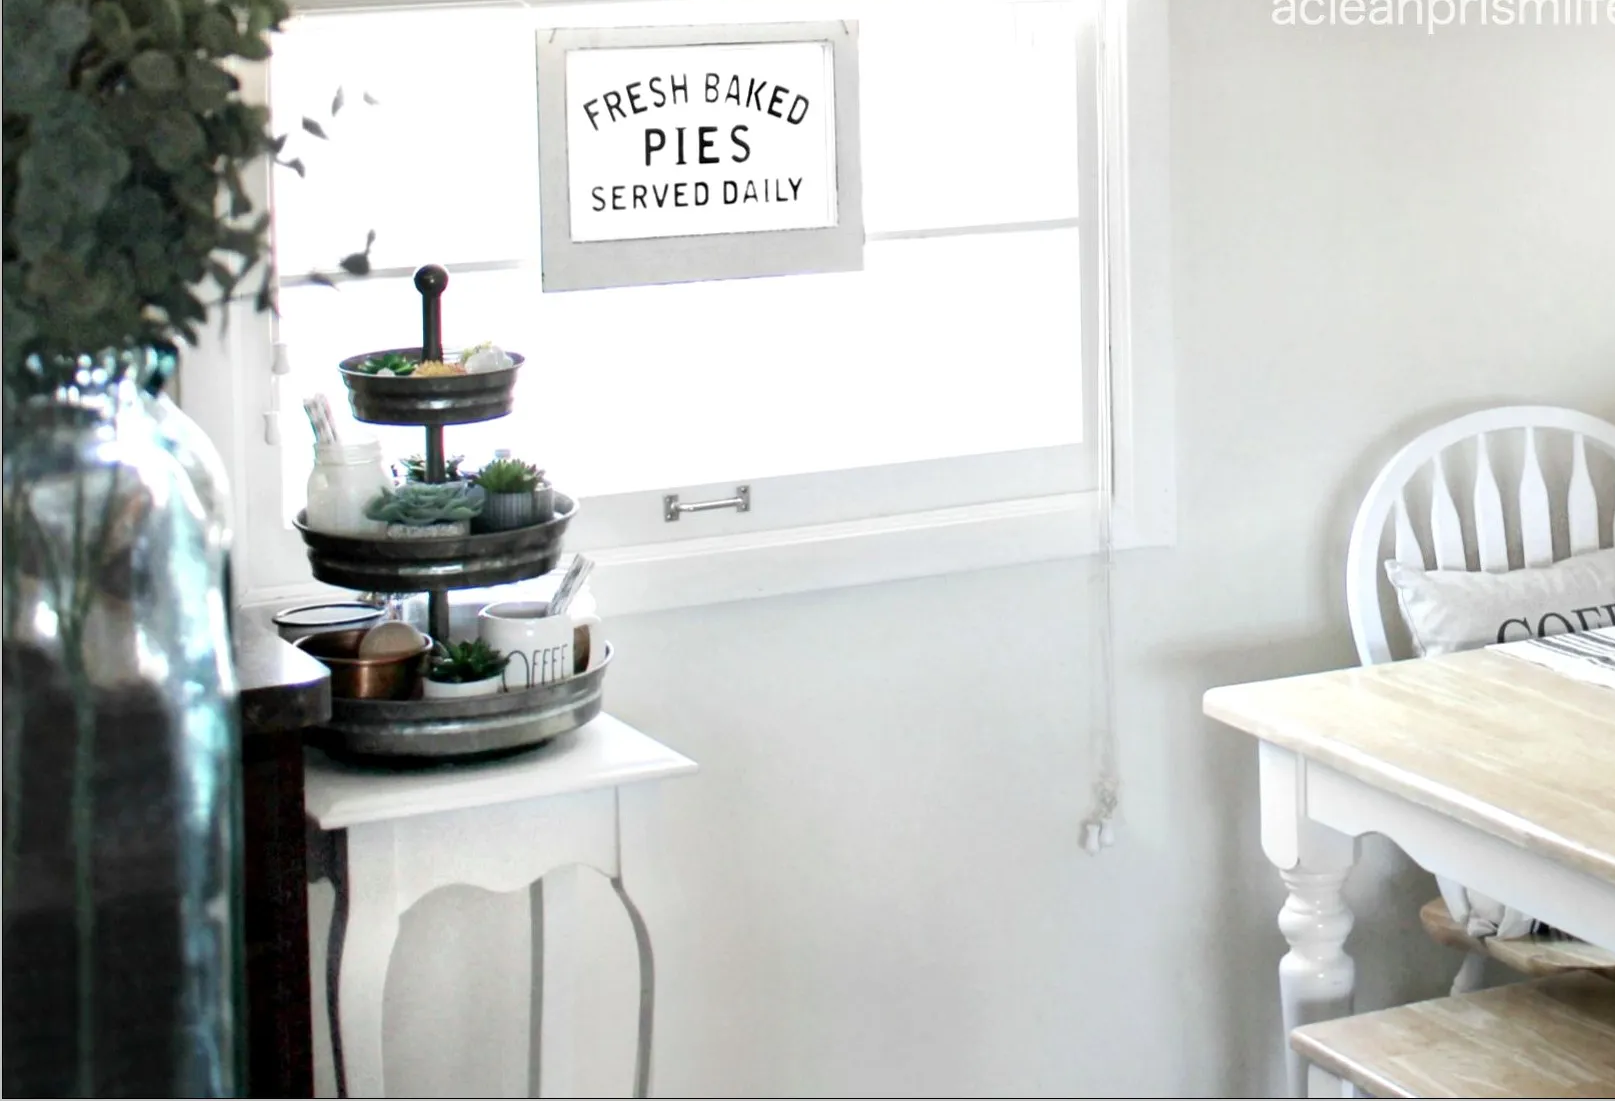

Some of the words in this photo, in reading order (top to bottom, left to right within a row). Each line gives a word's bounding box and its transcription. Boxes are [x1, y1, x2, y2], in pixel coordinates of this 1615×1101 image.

[582, 73, 689, 131] FRESH
[704, 72, 810, 125] BAKED
[644, 124, 751, 167] PIES
[591, 181, 709, 212] SERVED
[723, 177, 803, 205] DAILY
